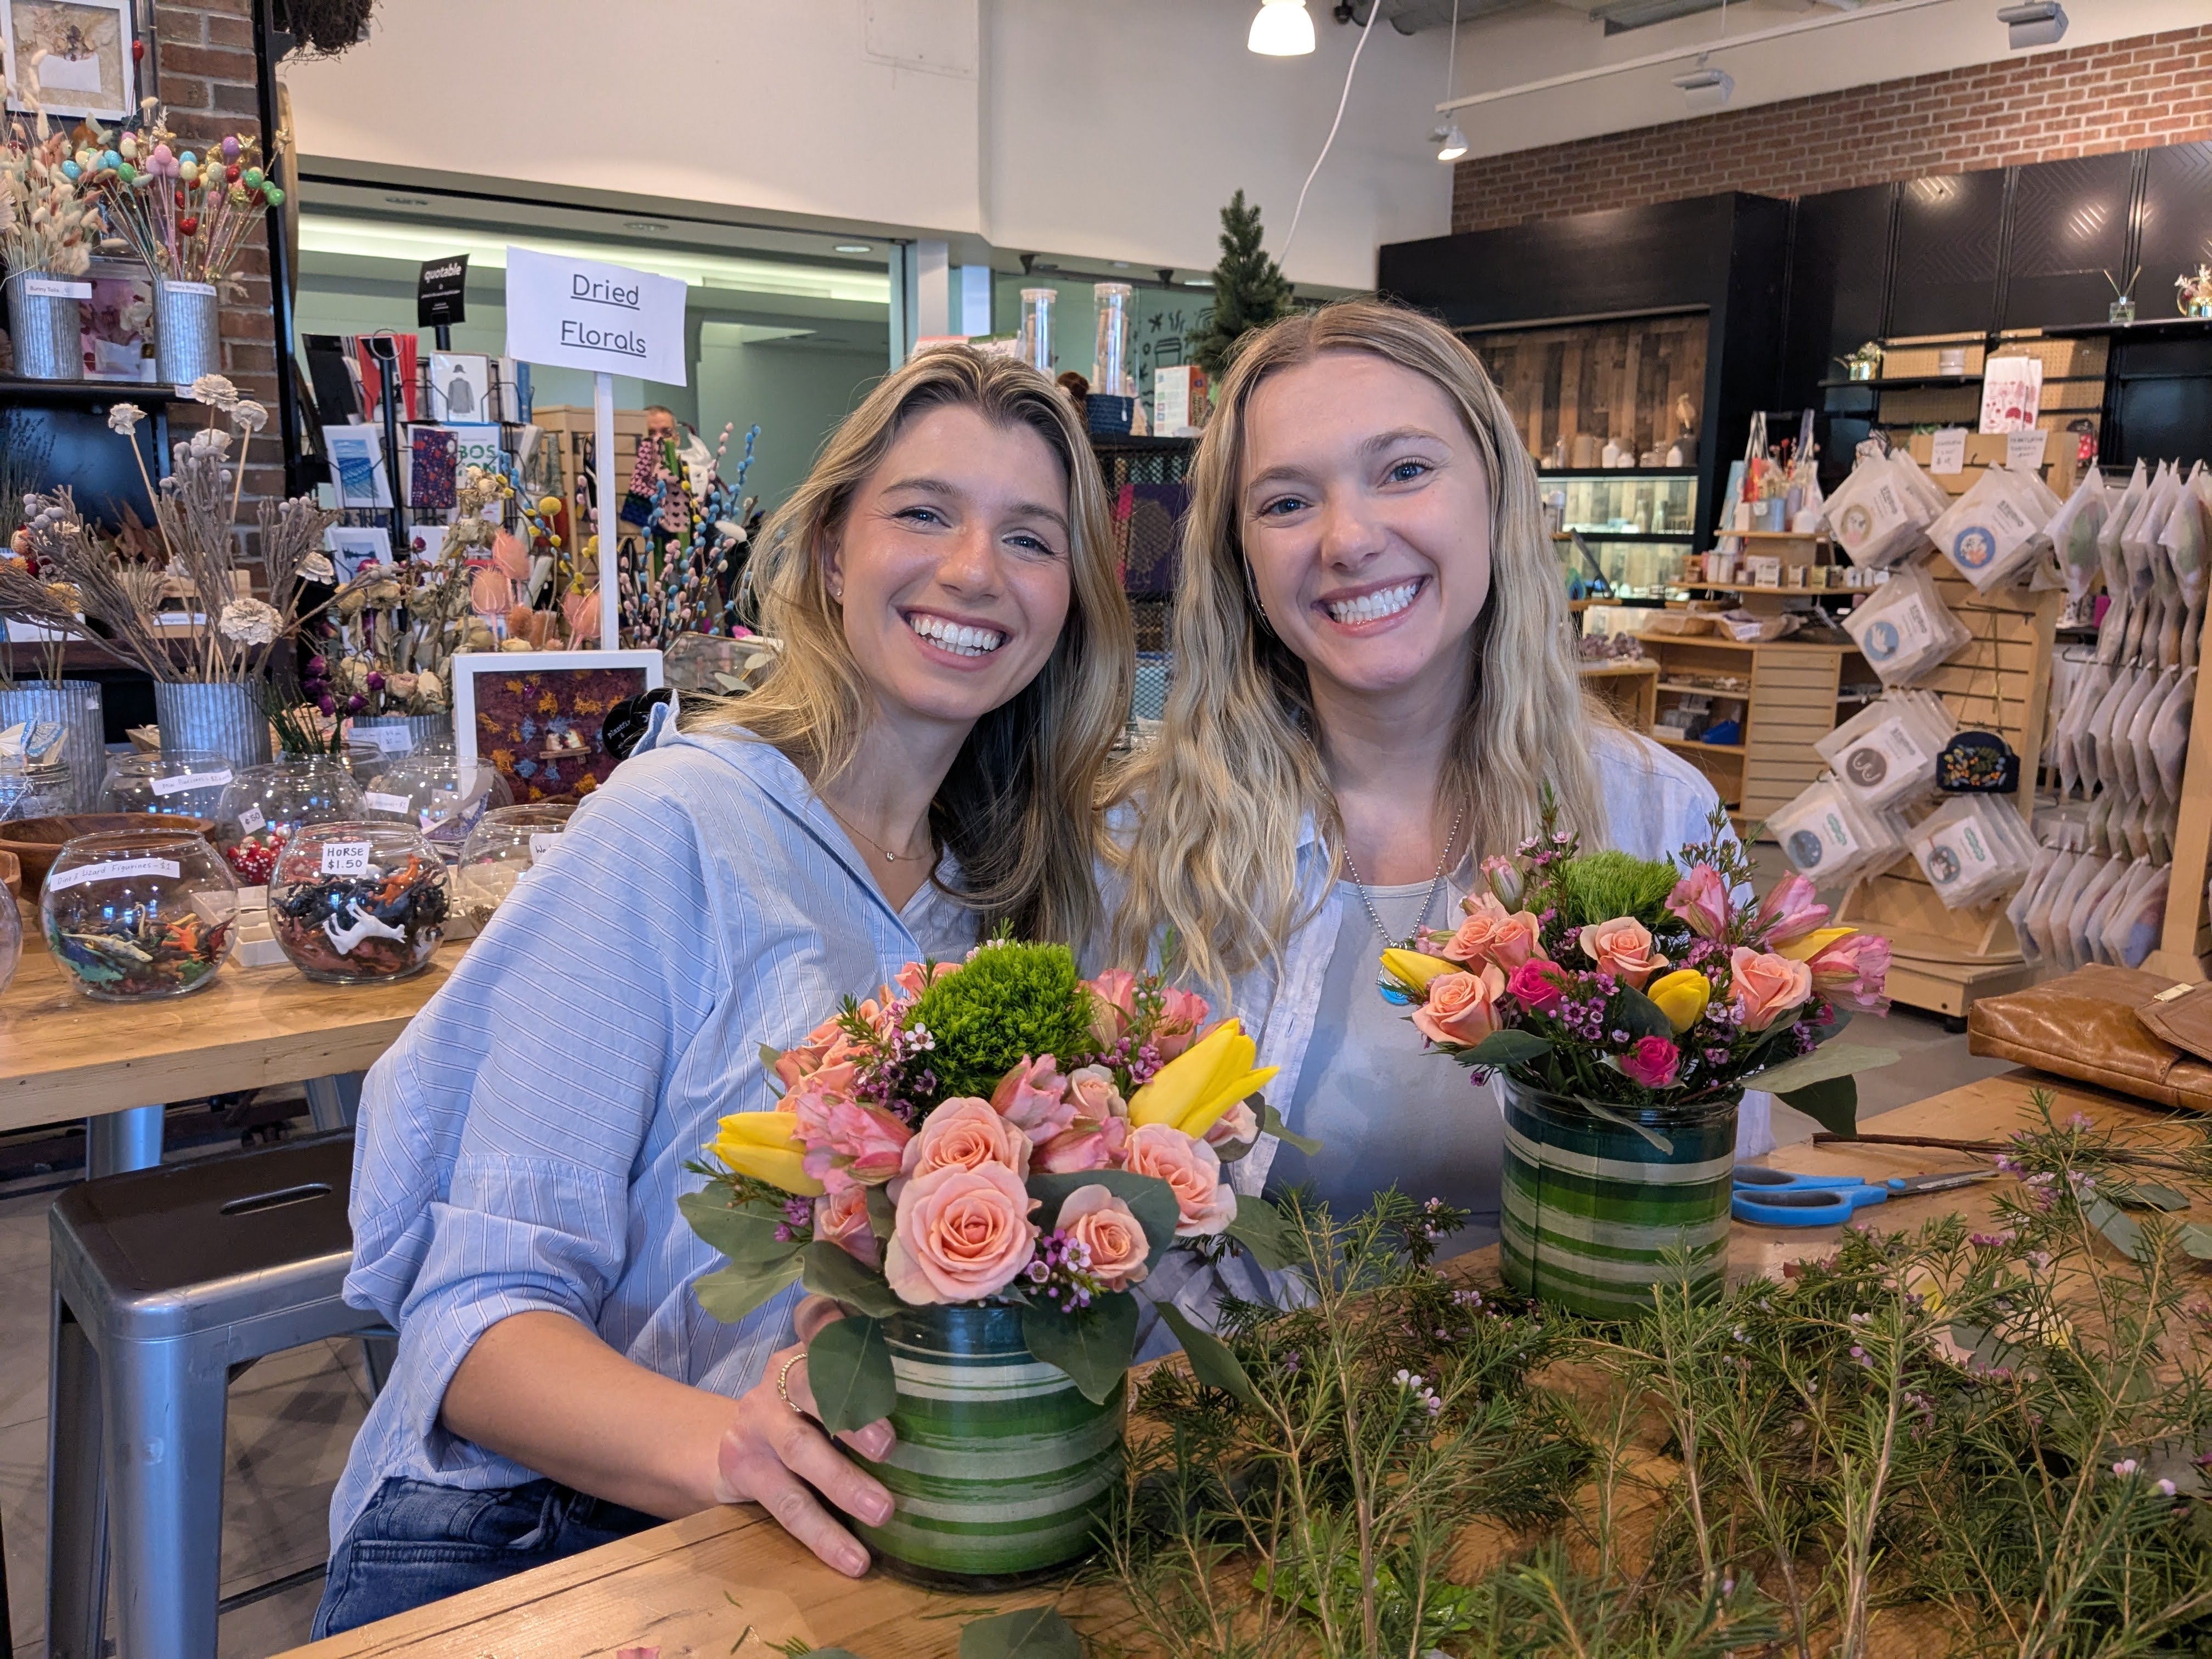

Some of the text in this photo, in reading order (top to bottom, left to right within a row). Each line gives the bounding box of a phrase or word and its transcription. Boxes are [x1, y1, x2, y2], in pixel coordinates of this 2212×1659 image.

[424, 262, 462, 284] quotable
[573, 274, 639, 306] Dried
[561, 320, 647, 354] Florals
[327, 847, 364, 857] HORSE
[58, 876, 72, 885] Dino
[82, 866, 106, 877] Lizard
[111, 862, 151, 873] Figurines
[328, 859, 363, 870] $1.50
